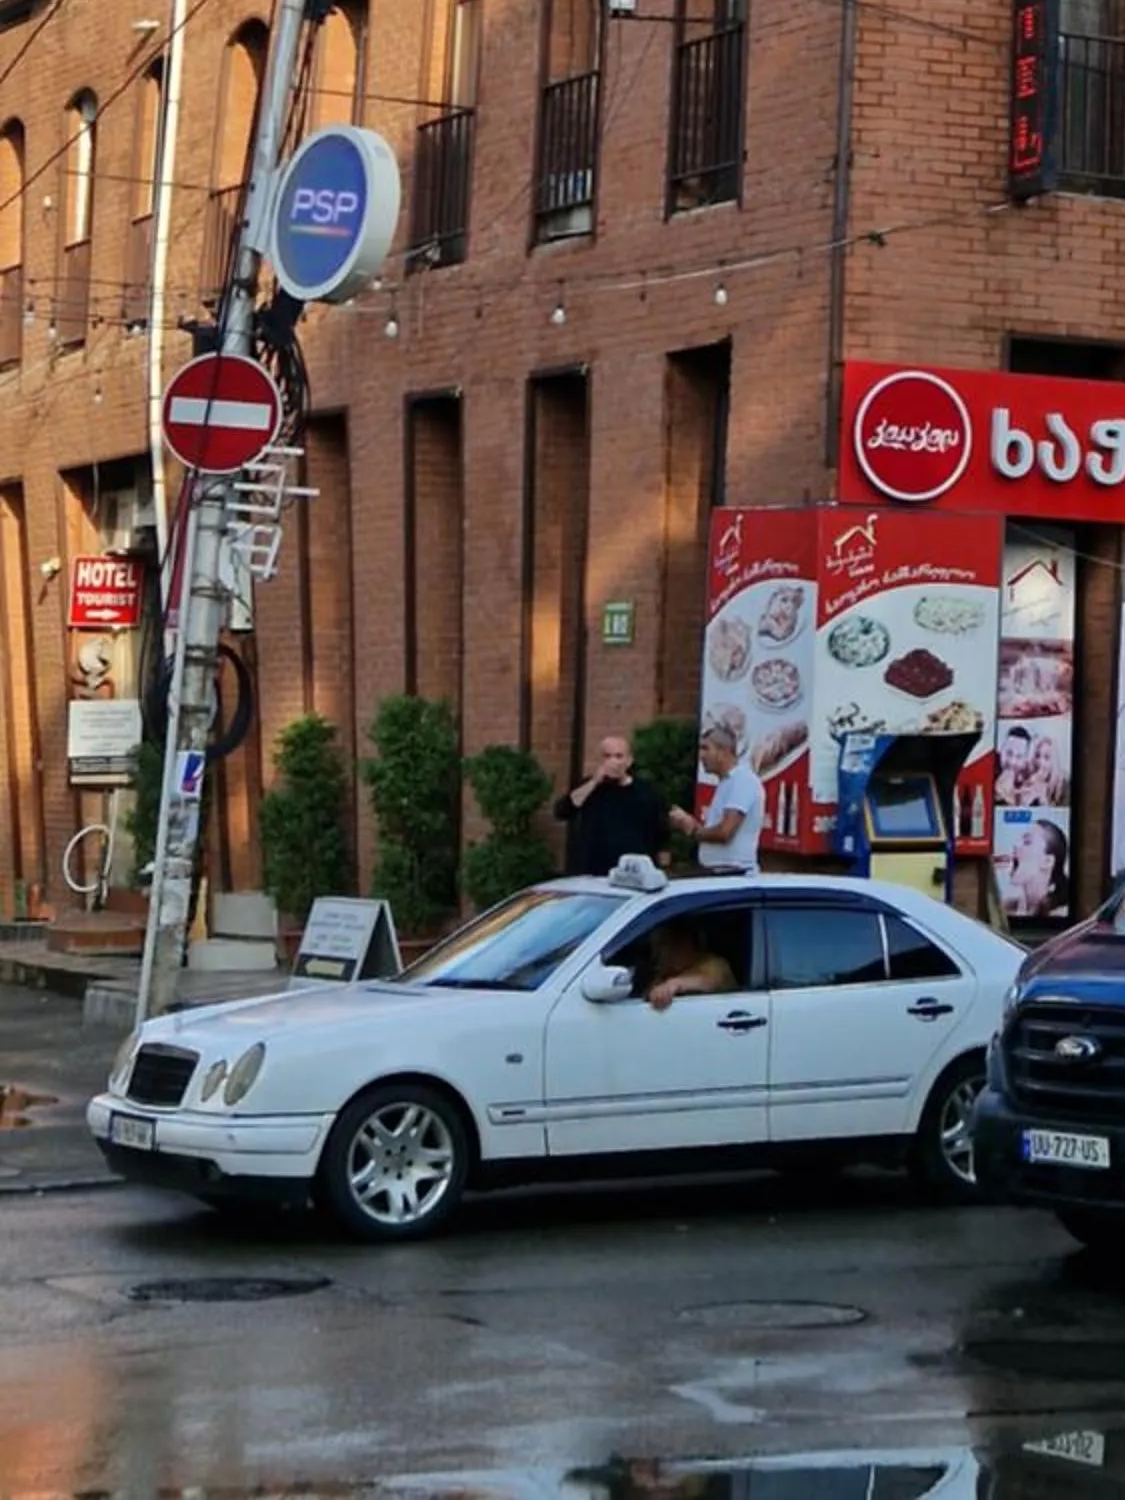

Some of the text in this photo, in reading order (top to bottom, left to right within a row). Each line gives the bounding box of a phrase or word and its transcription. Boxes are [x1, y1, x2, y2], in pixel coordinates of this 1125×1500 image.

[291, 188, 358, 223] PSP
[77, 561, 137, 589] HOTEL
[76, 591, 136, 608] TOURIST
